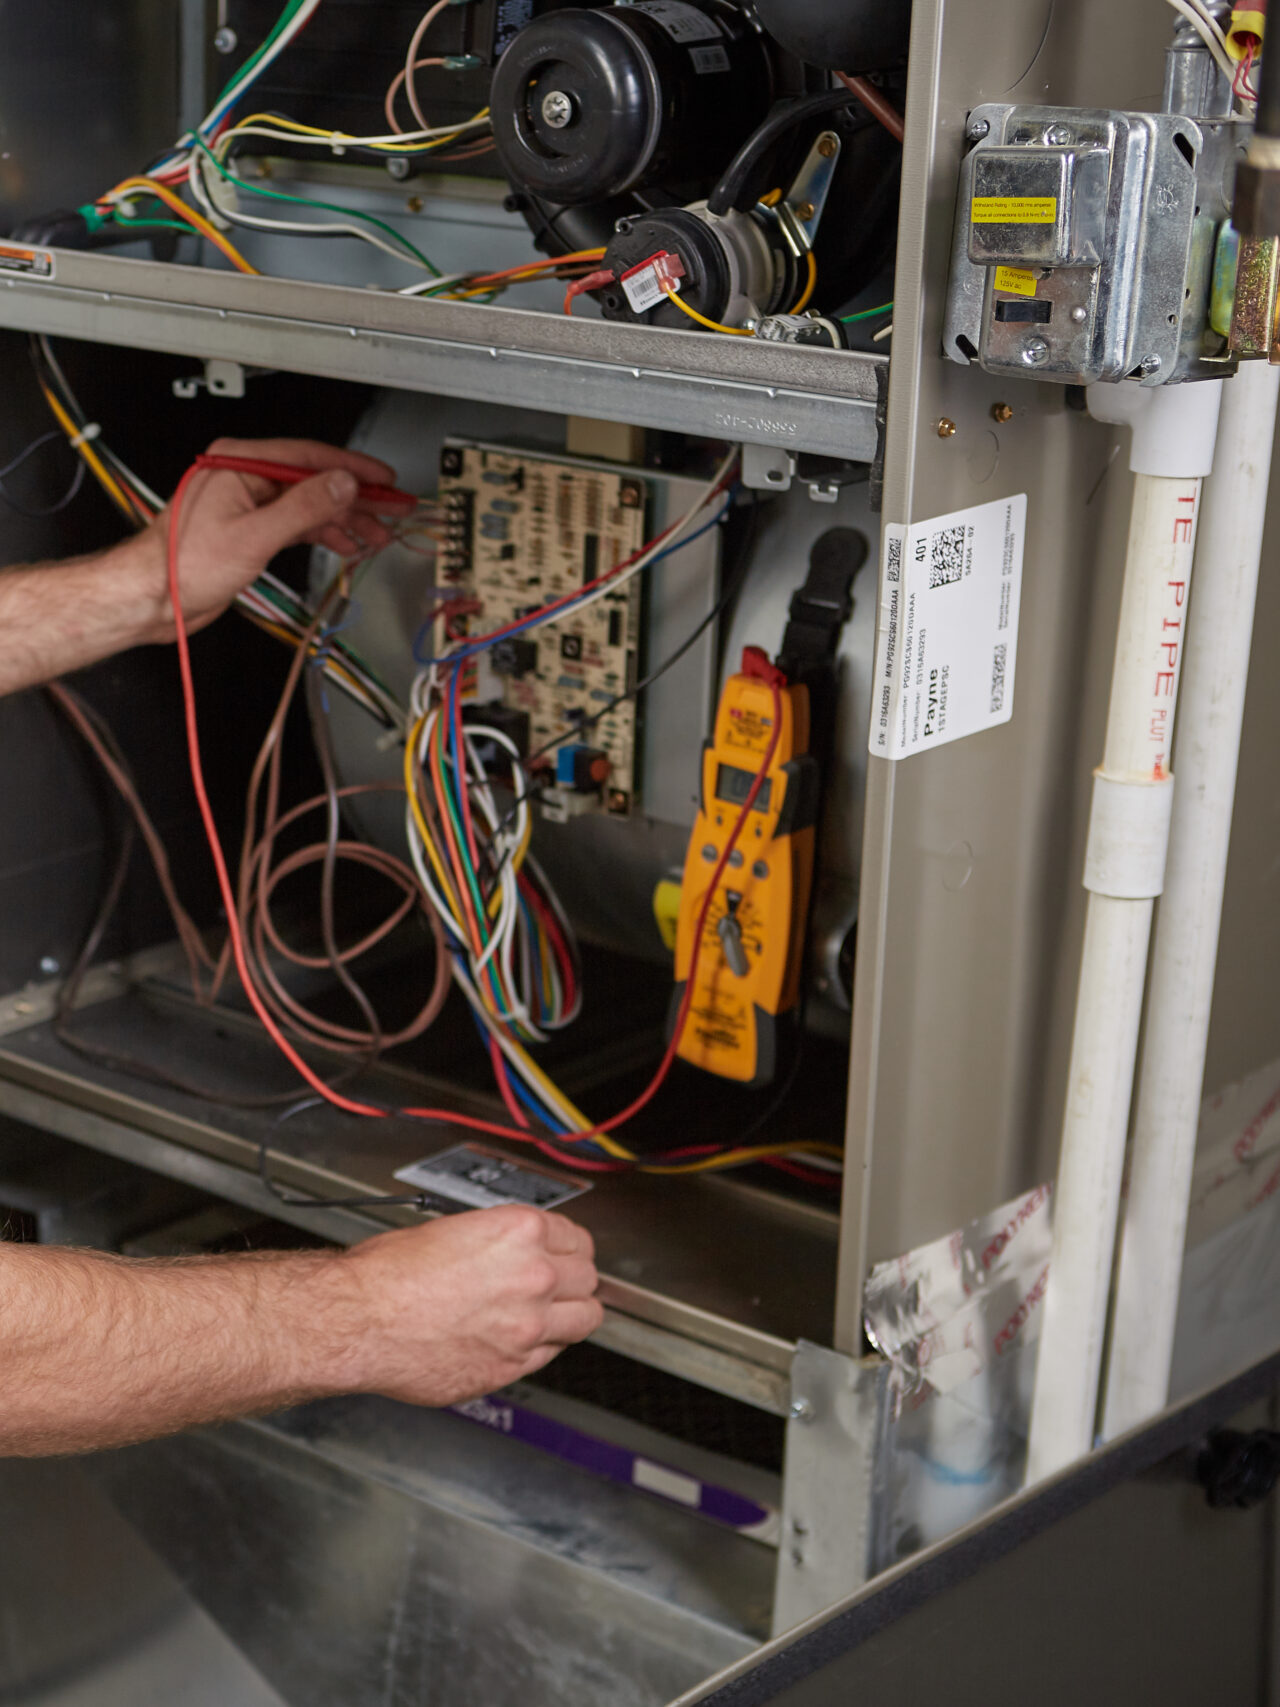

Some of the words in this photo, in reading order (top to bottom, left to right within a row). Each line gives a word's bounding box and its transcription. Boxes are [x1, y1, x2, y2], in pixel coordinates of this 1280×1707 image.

[1172, 479, 1198, 545] TE
[914, 537, 928, 562] 401
[1153, 580, 1186, 697] PIPE
[879, 685, 891, 727] 0316A63293
[923, 668, 939, 737] Payne
[938, 664, 950, 732] 1STAGEPSC
